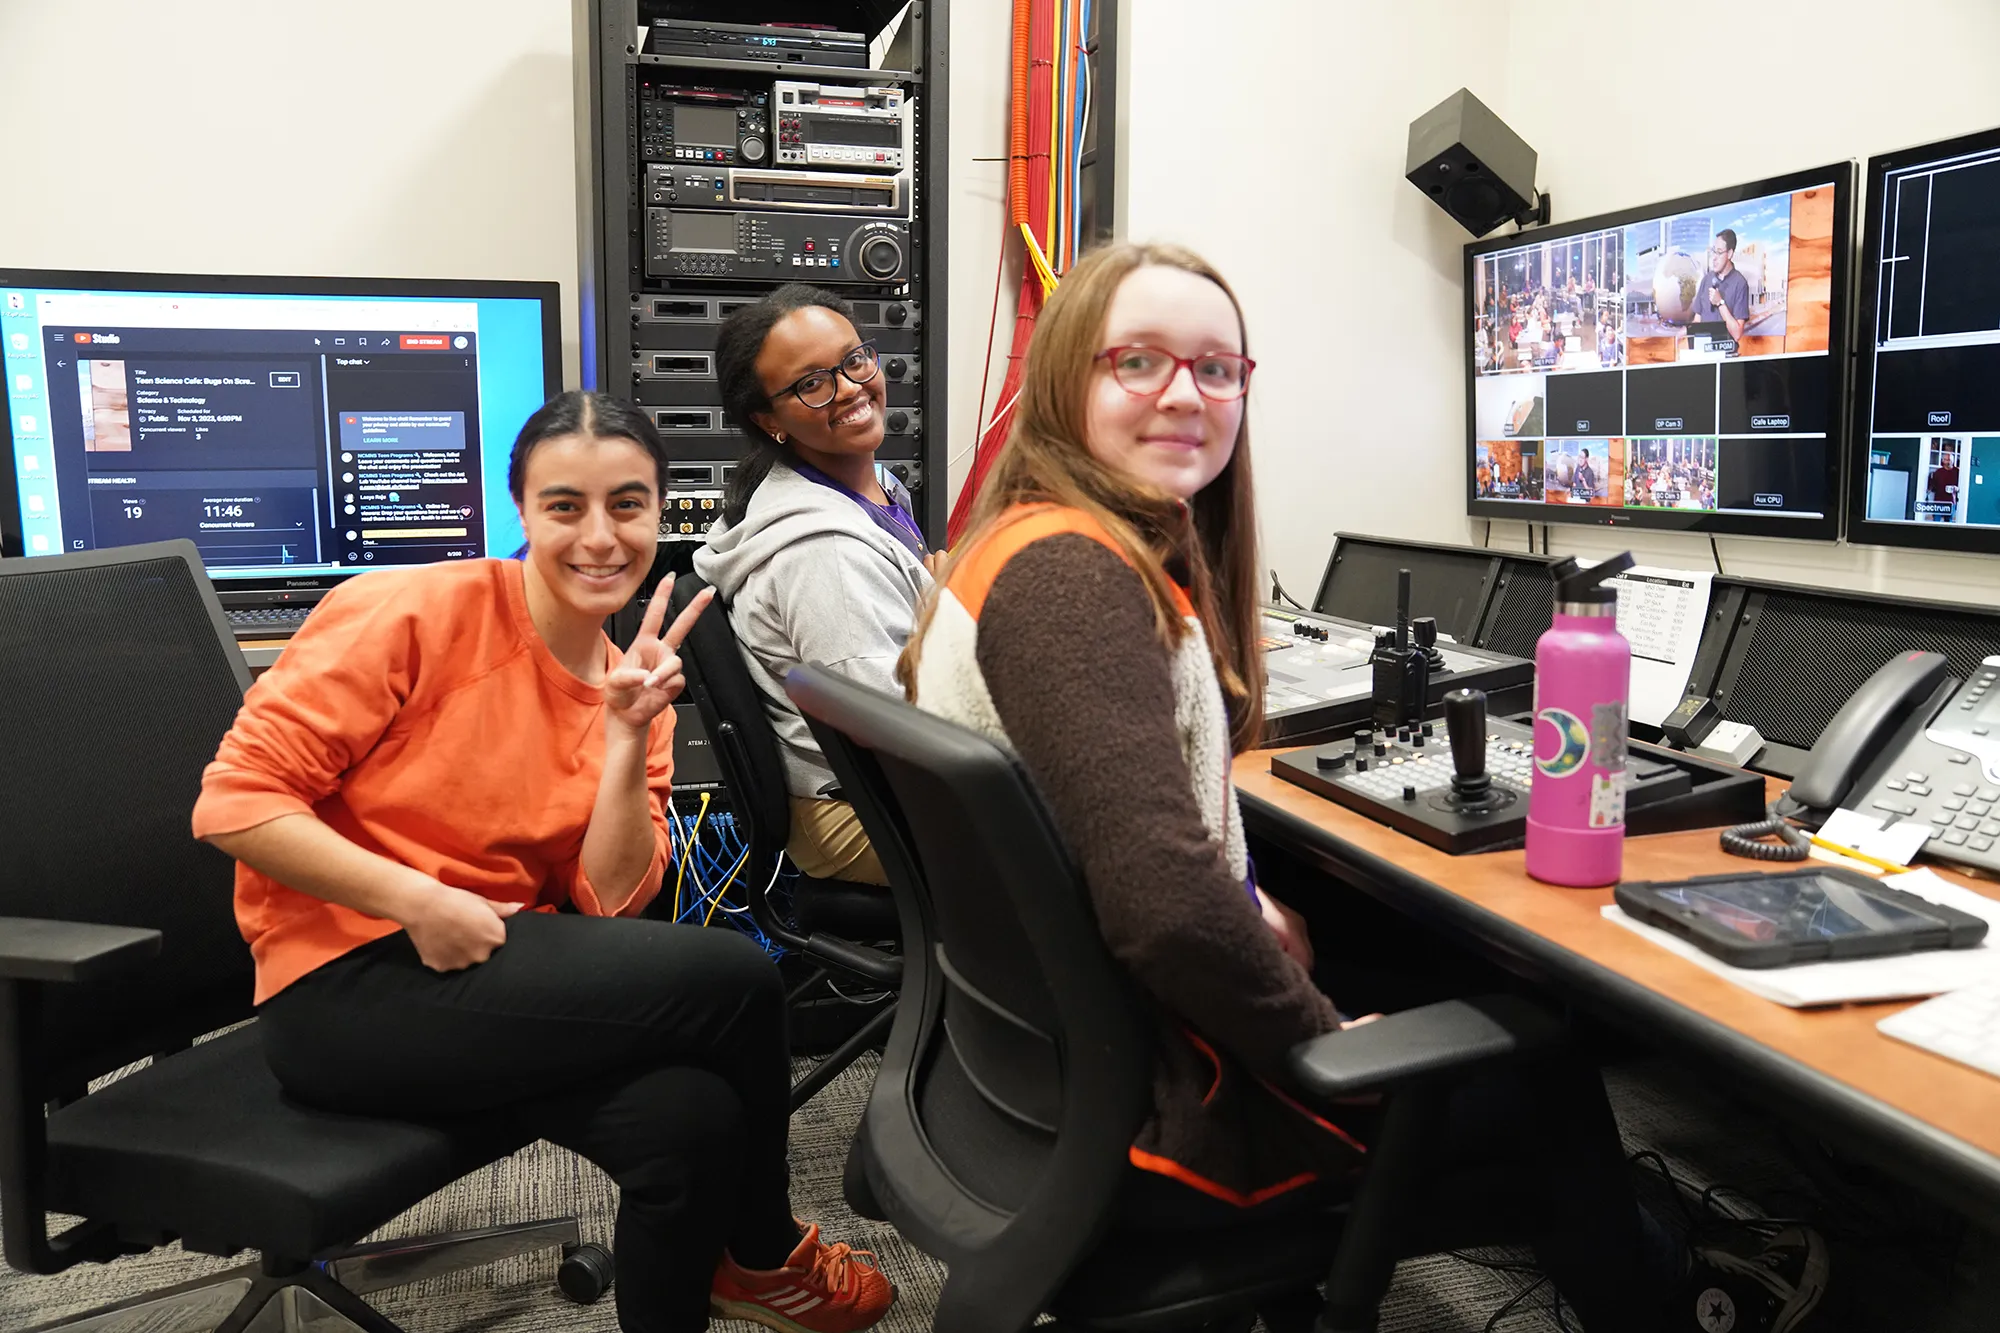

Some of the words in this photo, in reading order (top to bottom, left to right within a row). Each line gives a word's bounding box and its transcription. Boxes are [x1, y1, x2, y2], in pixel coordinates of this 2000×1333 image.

[92, 334, 120, 344] Studio
[1720, 341, 1733, 349] PGM
[204, 377, 222, 386] Bugs
[169, 397, 206, 405] Technology
[1767, 417, 1788, 427] Laptop
[1930, 414, 1948, 422] Roof
[124, 506, 142, 519] 19
[204, 505, 242, 517] 11:46
[1916, 502, 1951, 513] Spectrum
